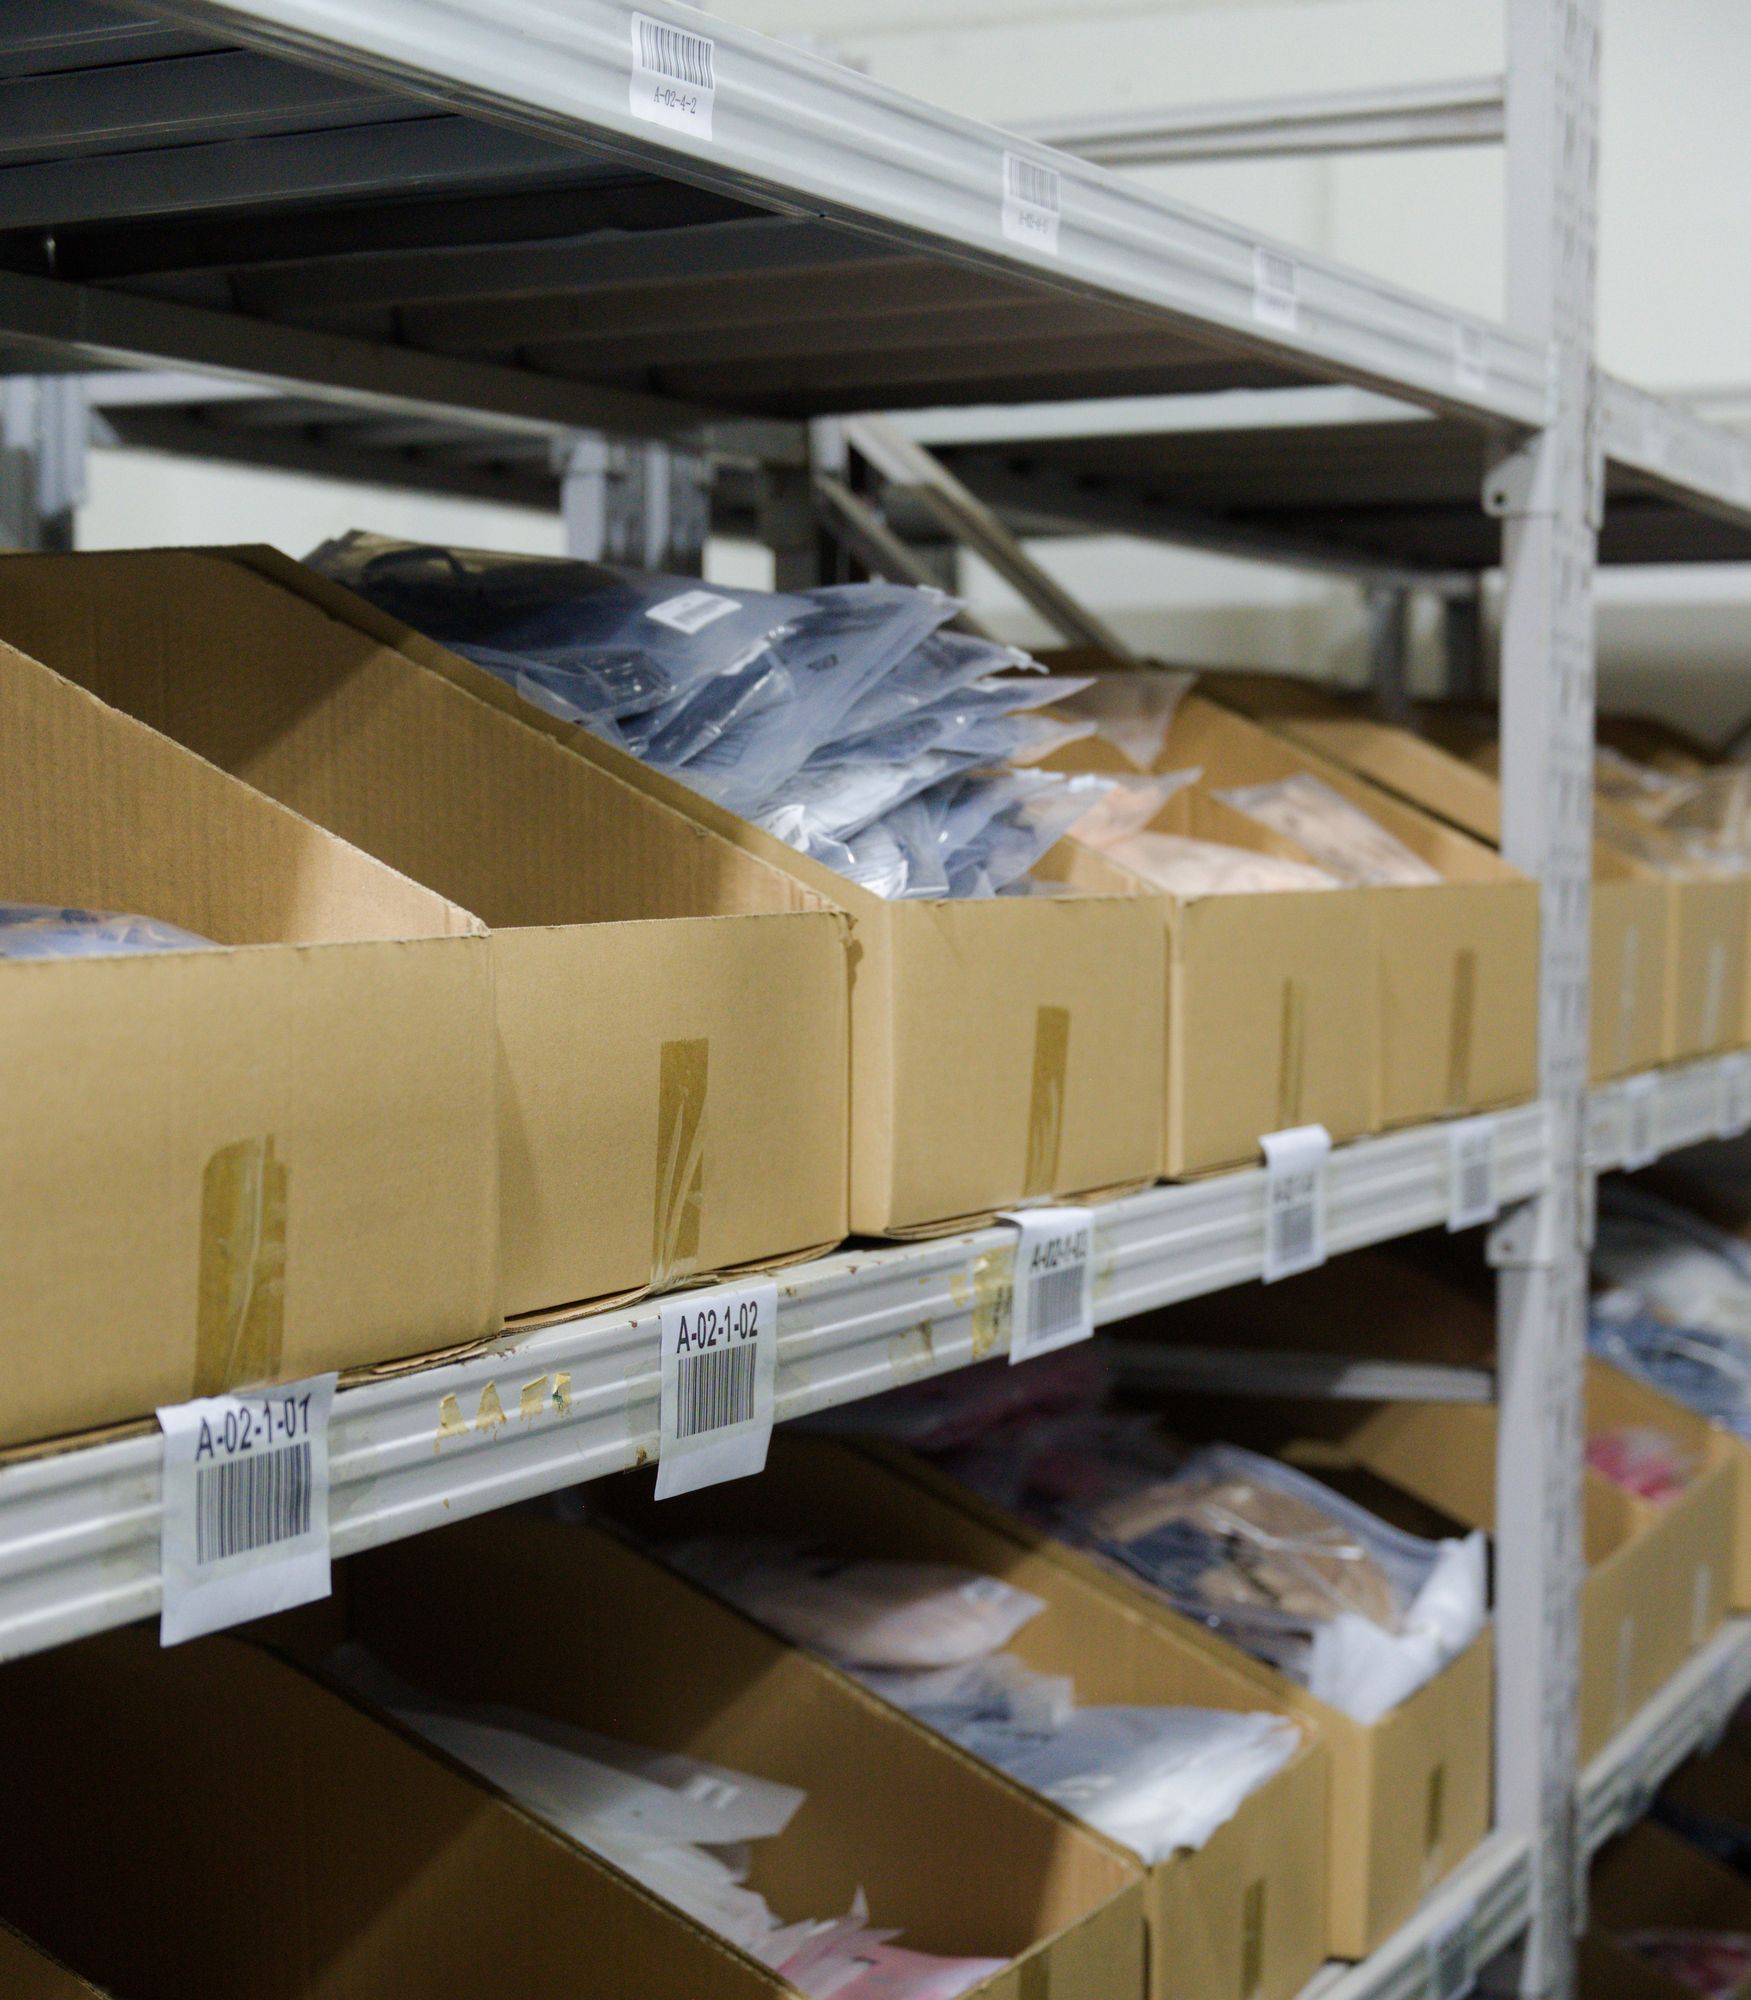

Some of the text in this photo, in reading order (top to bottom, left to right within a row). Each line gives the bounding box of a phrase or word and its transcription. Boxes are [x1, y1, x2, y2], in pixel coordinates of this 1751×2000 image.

[653, 85, 697, 115] A-02-4-2
[676, 1300, 758, 1354] A-02-1-02
[195, 1391, 312, 1462] A-02-1-01
